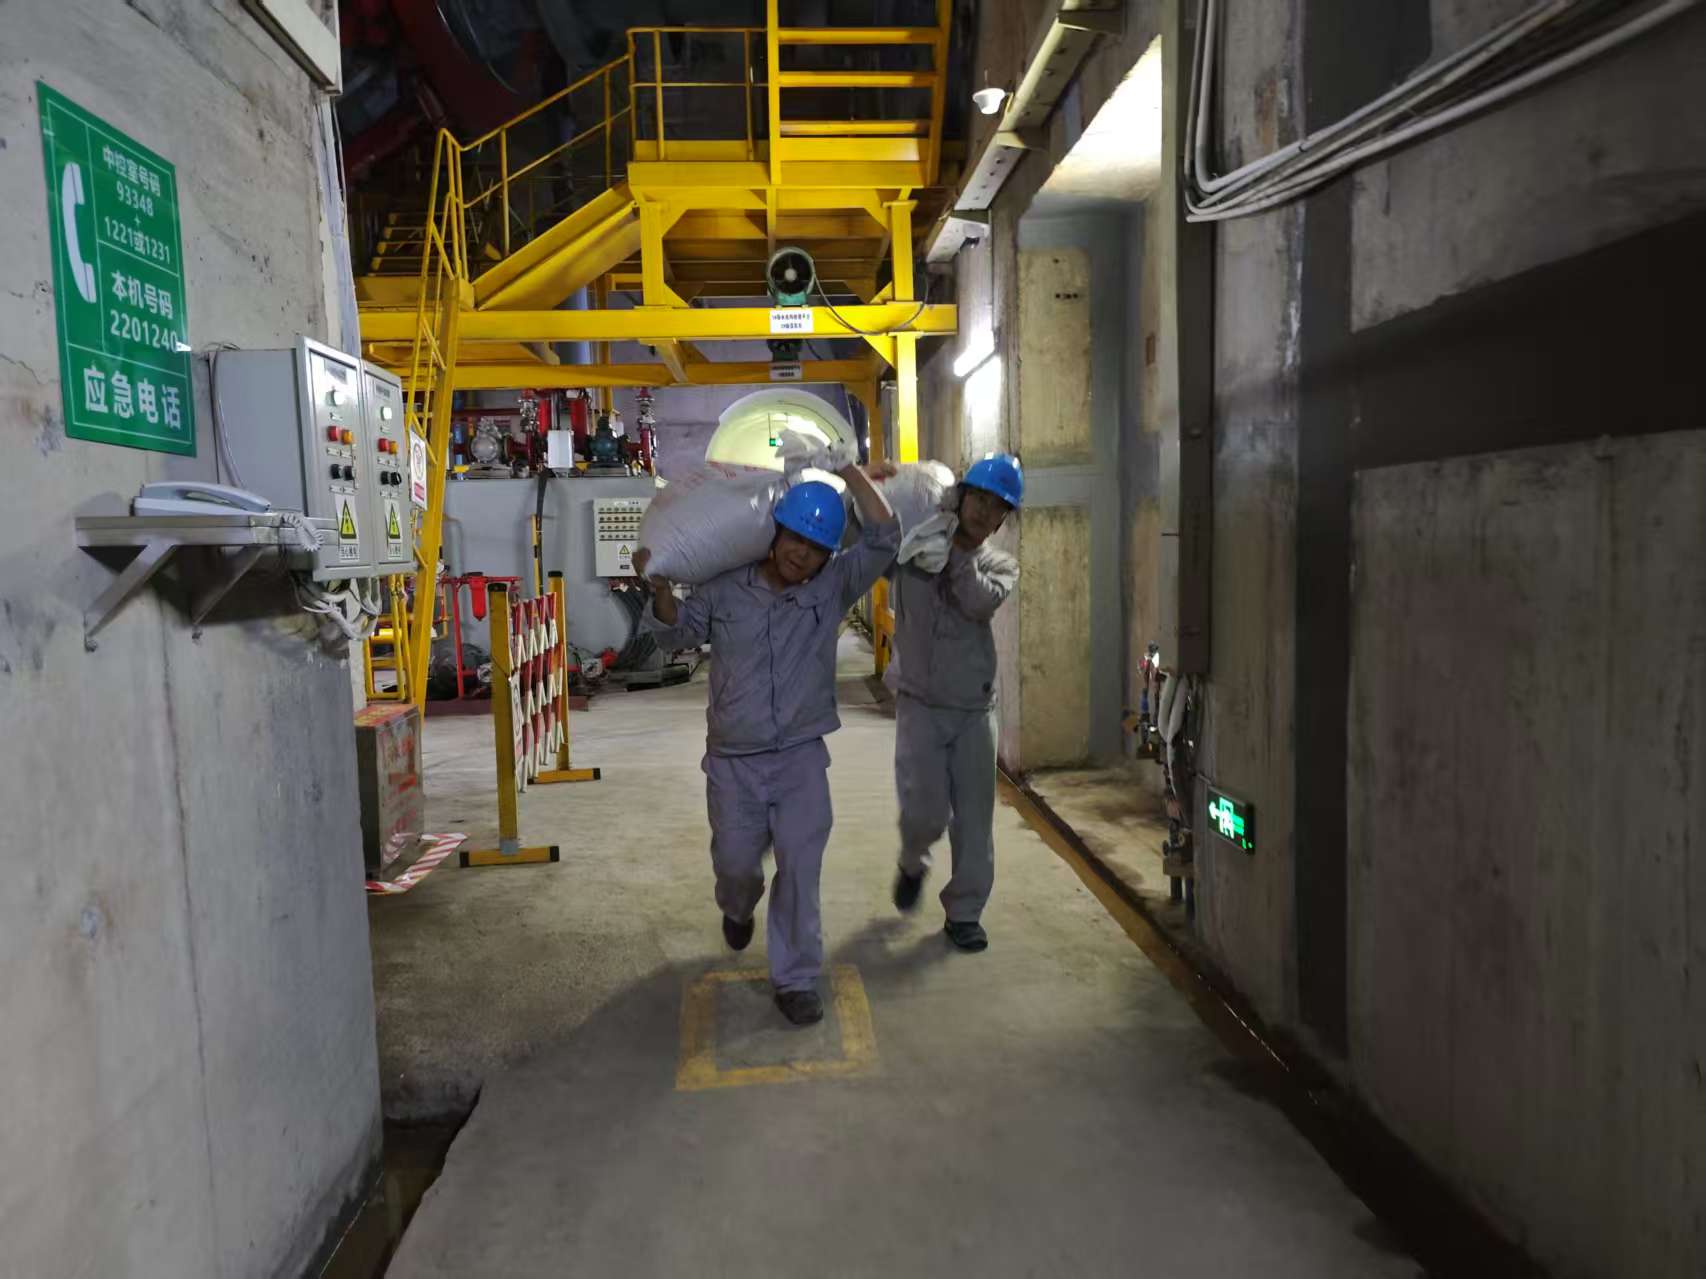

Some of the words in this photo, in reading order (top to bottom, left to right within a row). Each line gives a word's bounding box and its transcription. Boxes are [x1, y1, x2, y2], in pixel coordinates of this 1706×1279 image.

[103, 145, 161, 197] 中控室号码
[116, 181, 154, 217] 93348
[104, 215, 170, 264] 1221或1231
[112, 270, 173, 320] 本机号码
[110, 309, 178, 353] 2201240
[83, 361, 181, 430] 应急电话
